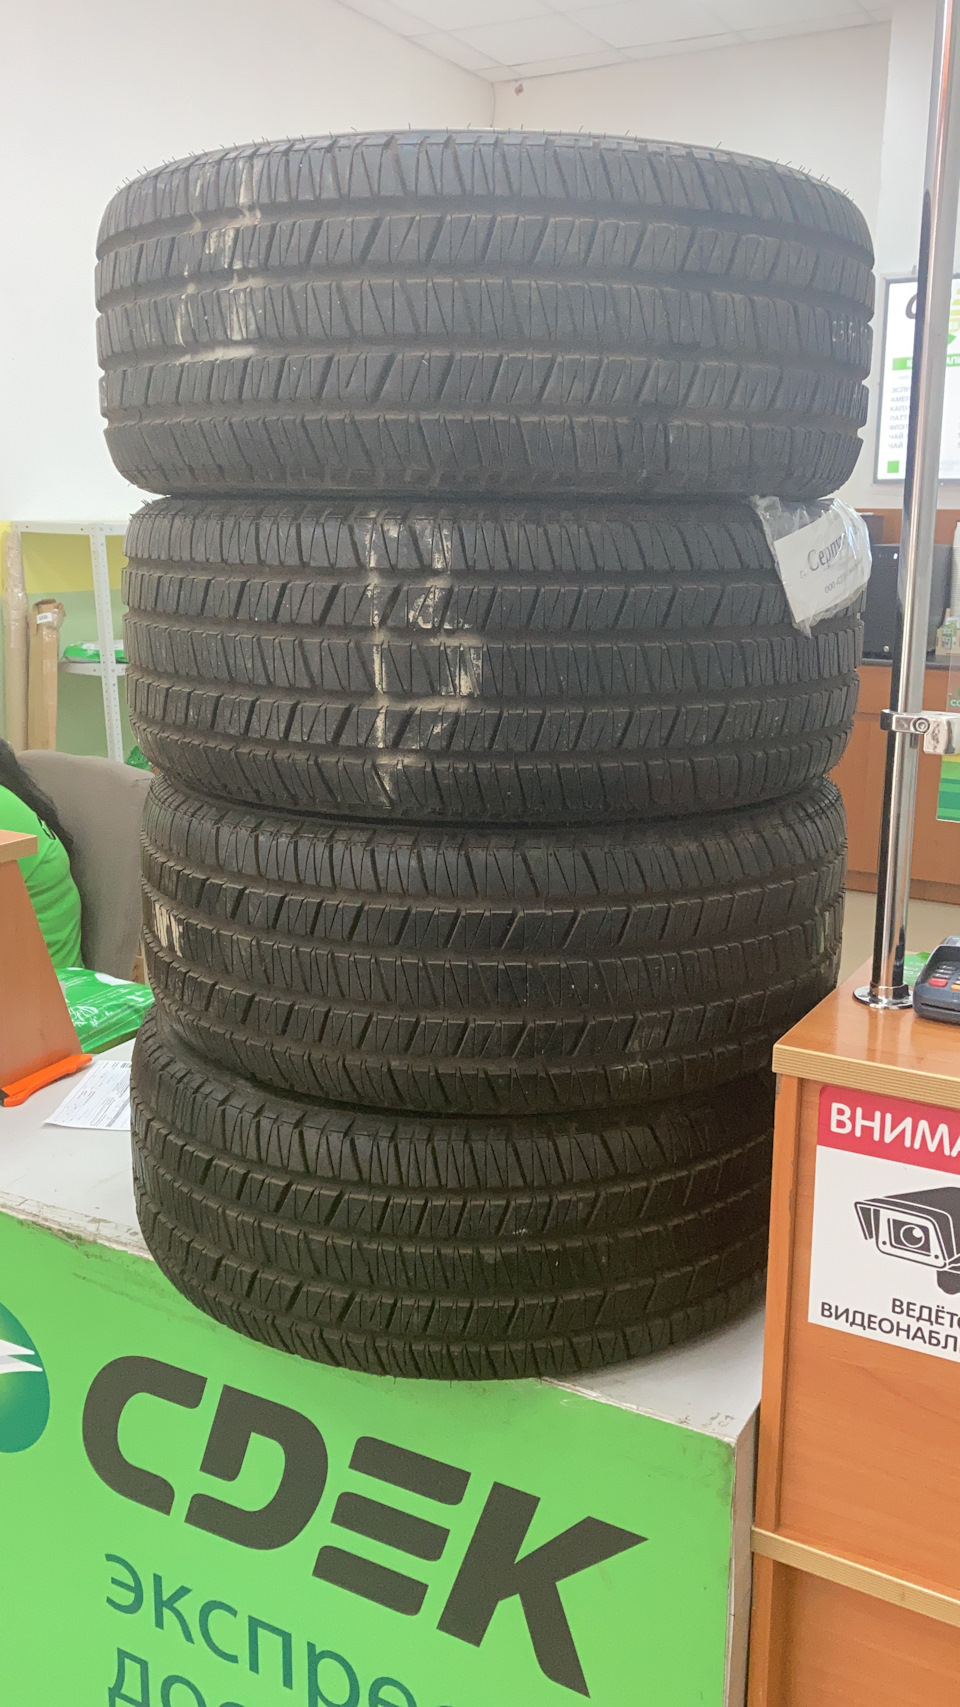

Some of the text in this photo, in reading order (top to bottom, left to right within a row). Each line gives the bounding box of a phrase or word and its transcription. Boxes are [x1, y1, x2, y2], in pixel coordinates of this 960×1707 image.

[820, 1301, 960, 1353] ВИДЕОНАБЛ
[891, 1298, 960, 1329] ВЕДЁТ
[82, 1355, 649, 1699] CDEK
[104, 1553, 455, 1707] экспре
